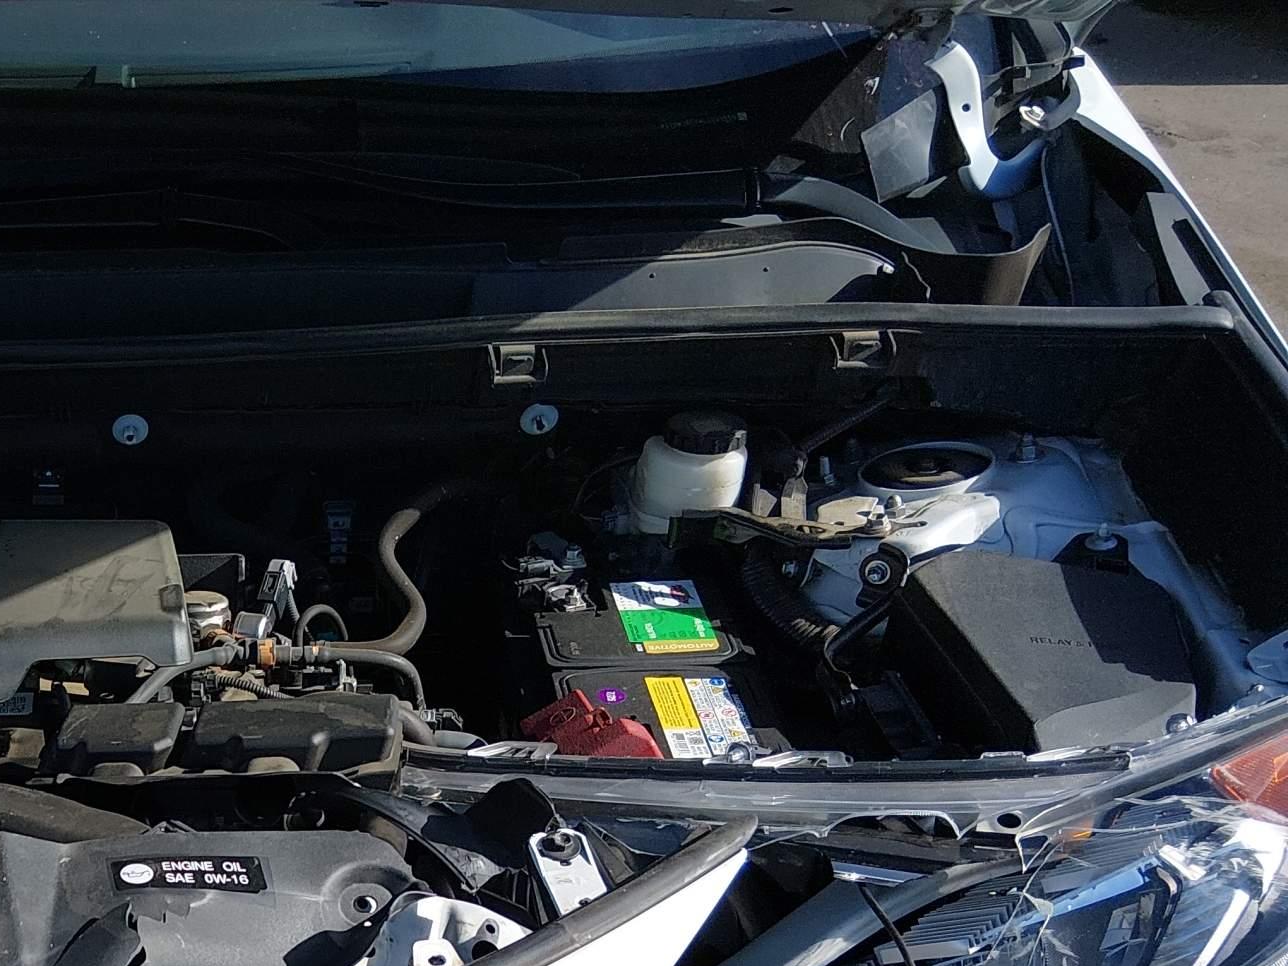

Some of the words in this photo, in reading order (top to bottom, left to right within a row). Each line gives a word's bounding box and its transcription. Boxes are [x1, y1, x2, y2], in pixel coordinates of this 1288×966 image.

[647, 643, 716, 651] AUTOMOTIVE
[1030, 636, 1073, 647] RELAY
[161, 860, 215, 872] ENGINE
[222, 861, 247, 873] OIL
[165, 873, 196, 884] SAE
[204, 873, 249, 885] 0W-16
